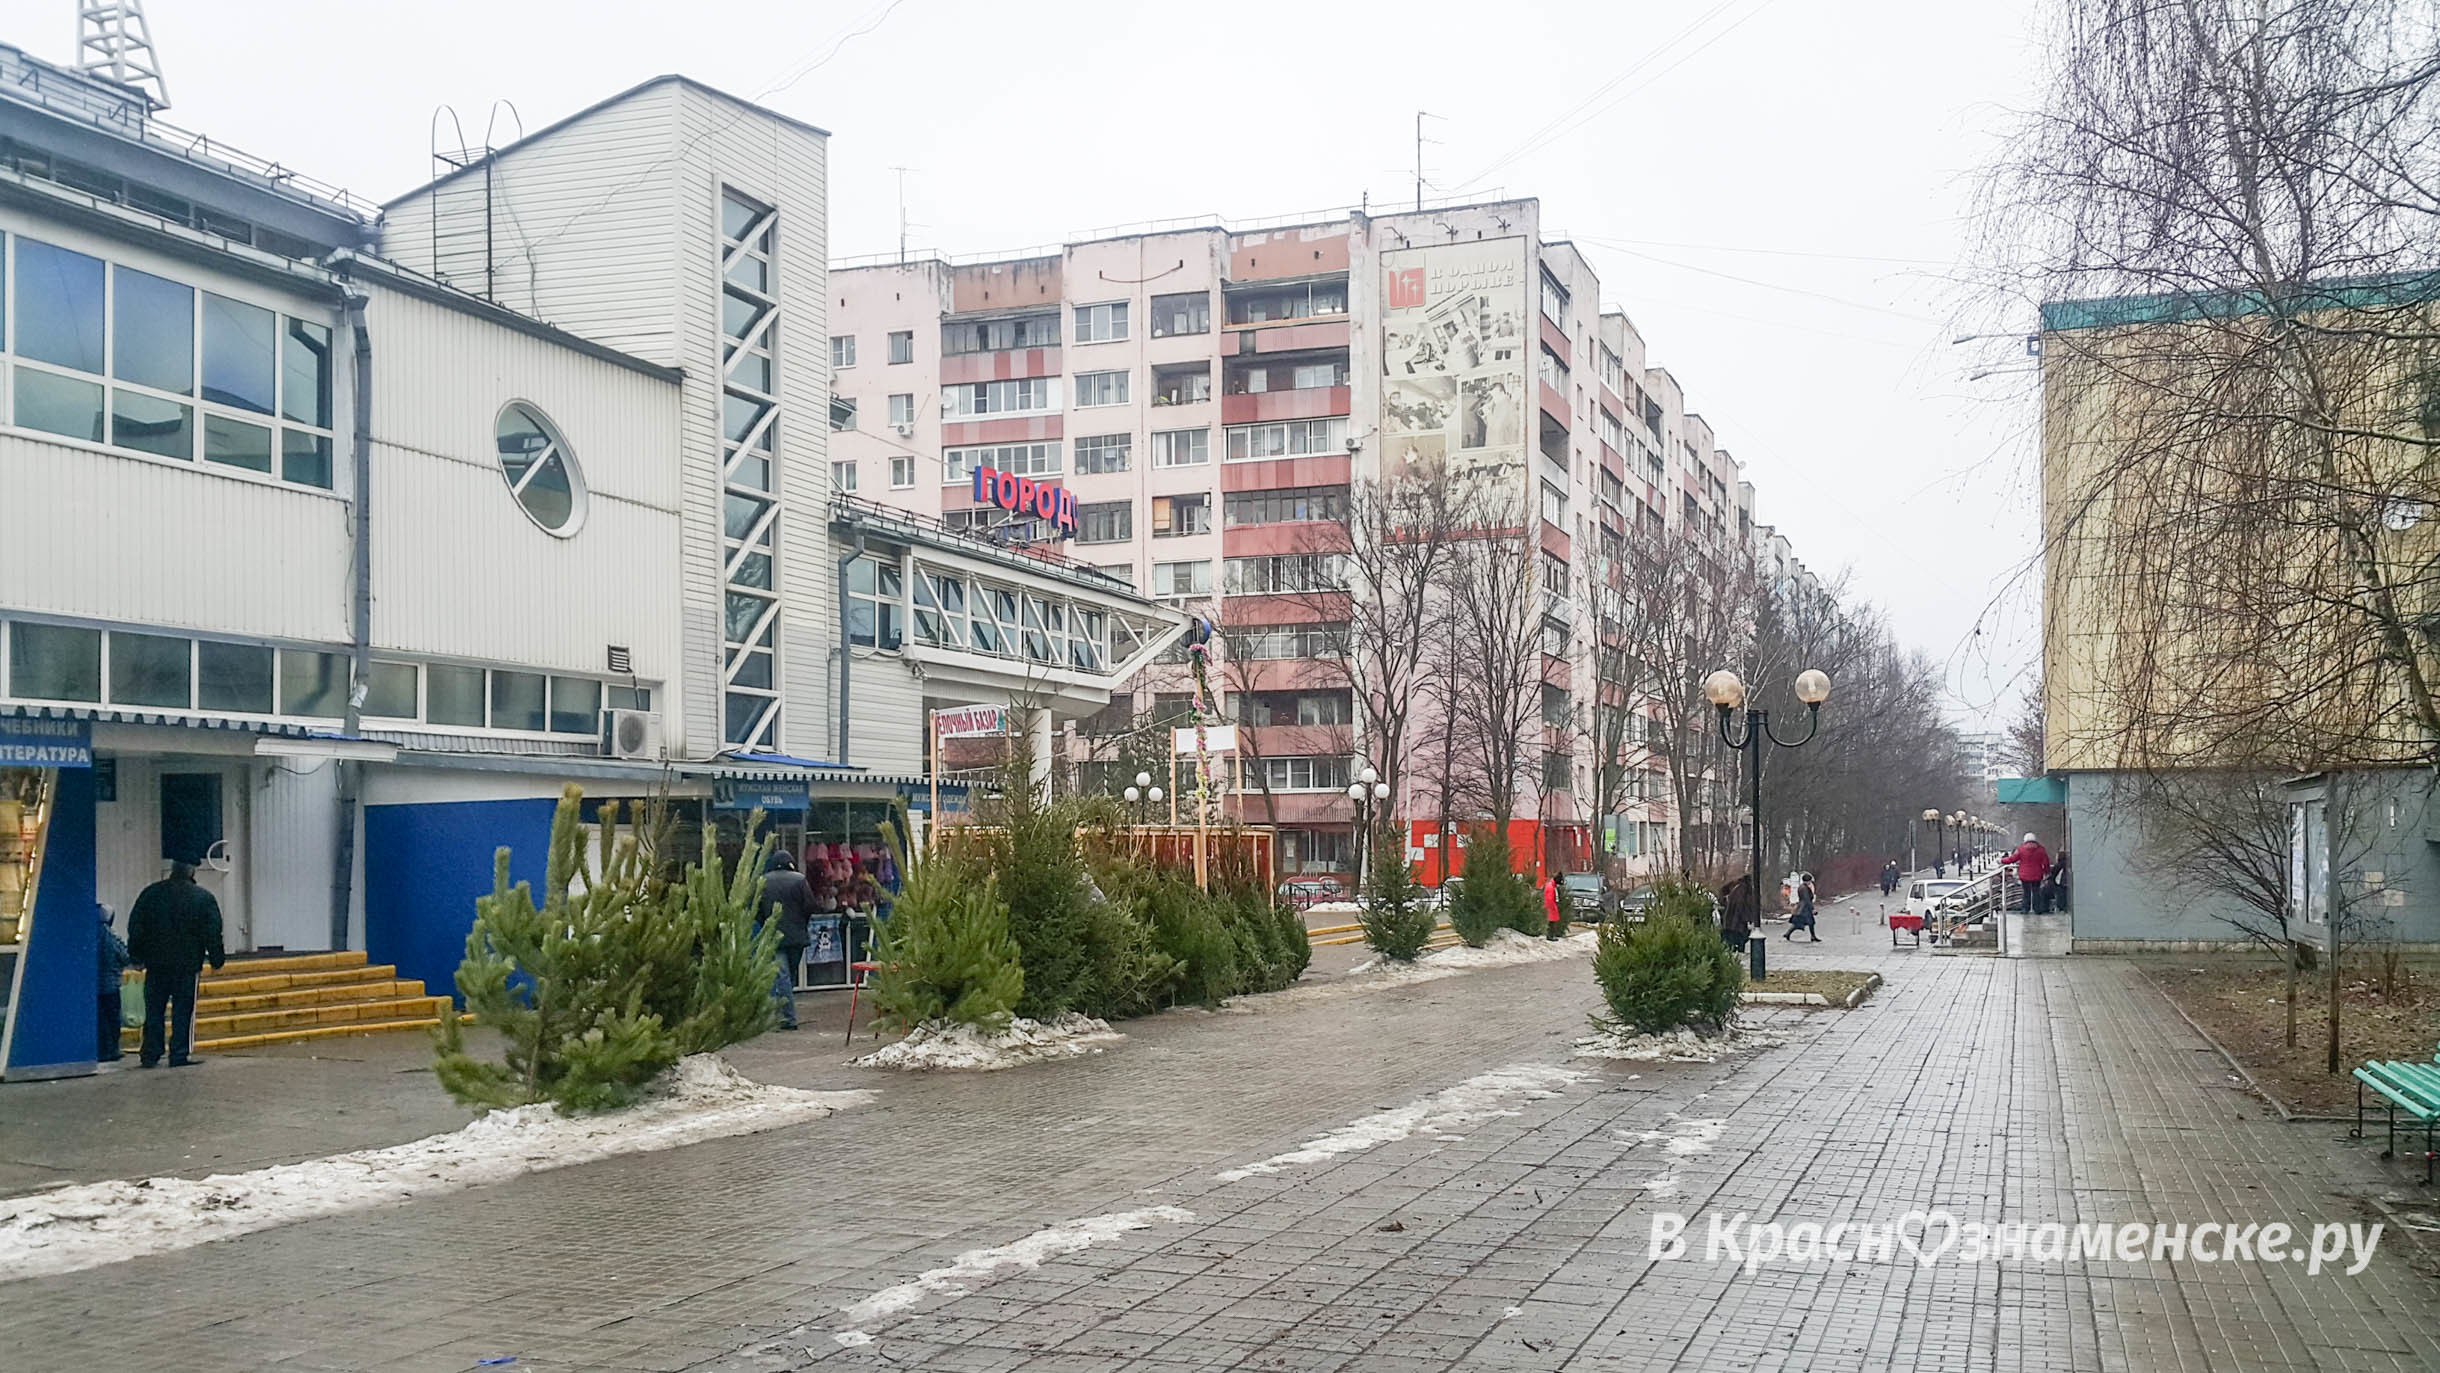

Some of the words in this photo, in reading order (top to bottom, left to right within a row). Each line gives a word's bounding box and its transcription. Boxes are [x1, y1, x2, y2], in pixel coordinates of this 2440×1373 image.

[973, 465, 1079, 533] ГОРОД
[935, 708, 975, 736] ЁЛОЧНЫЙ
[973, 709, 997, 731] БАЗАР
